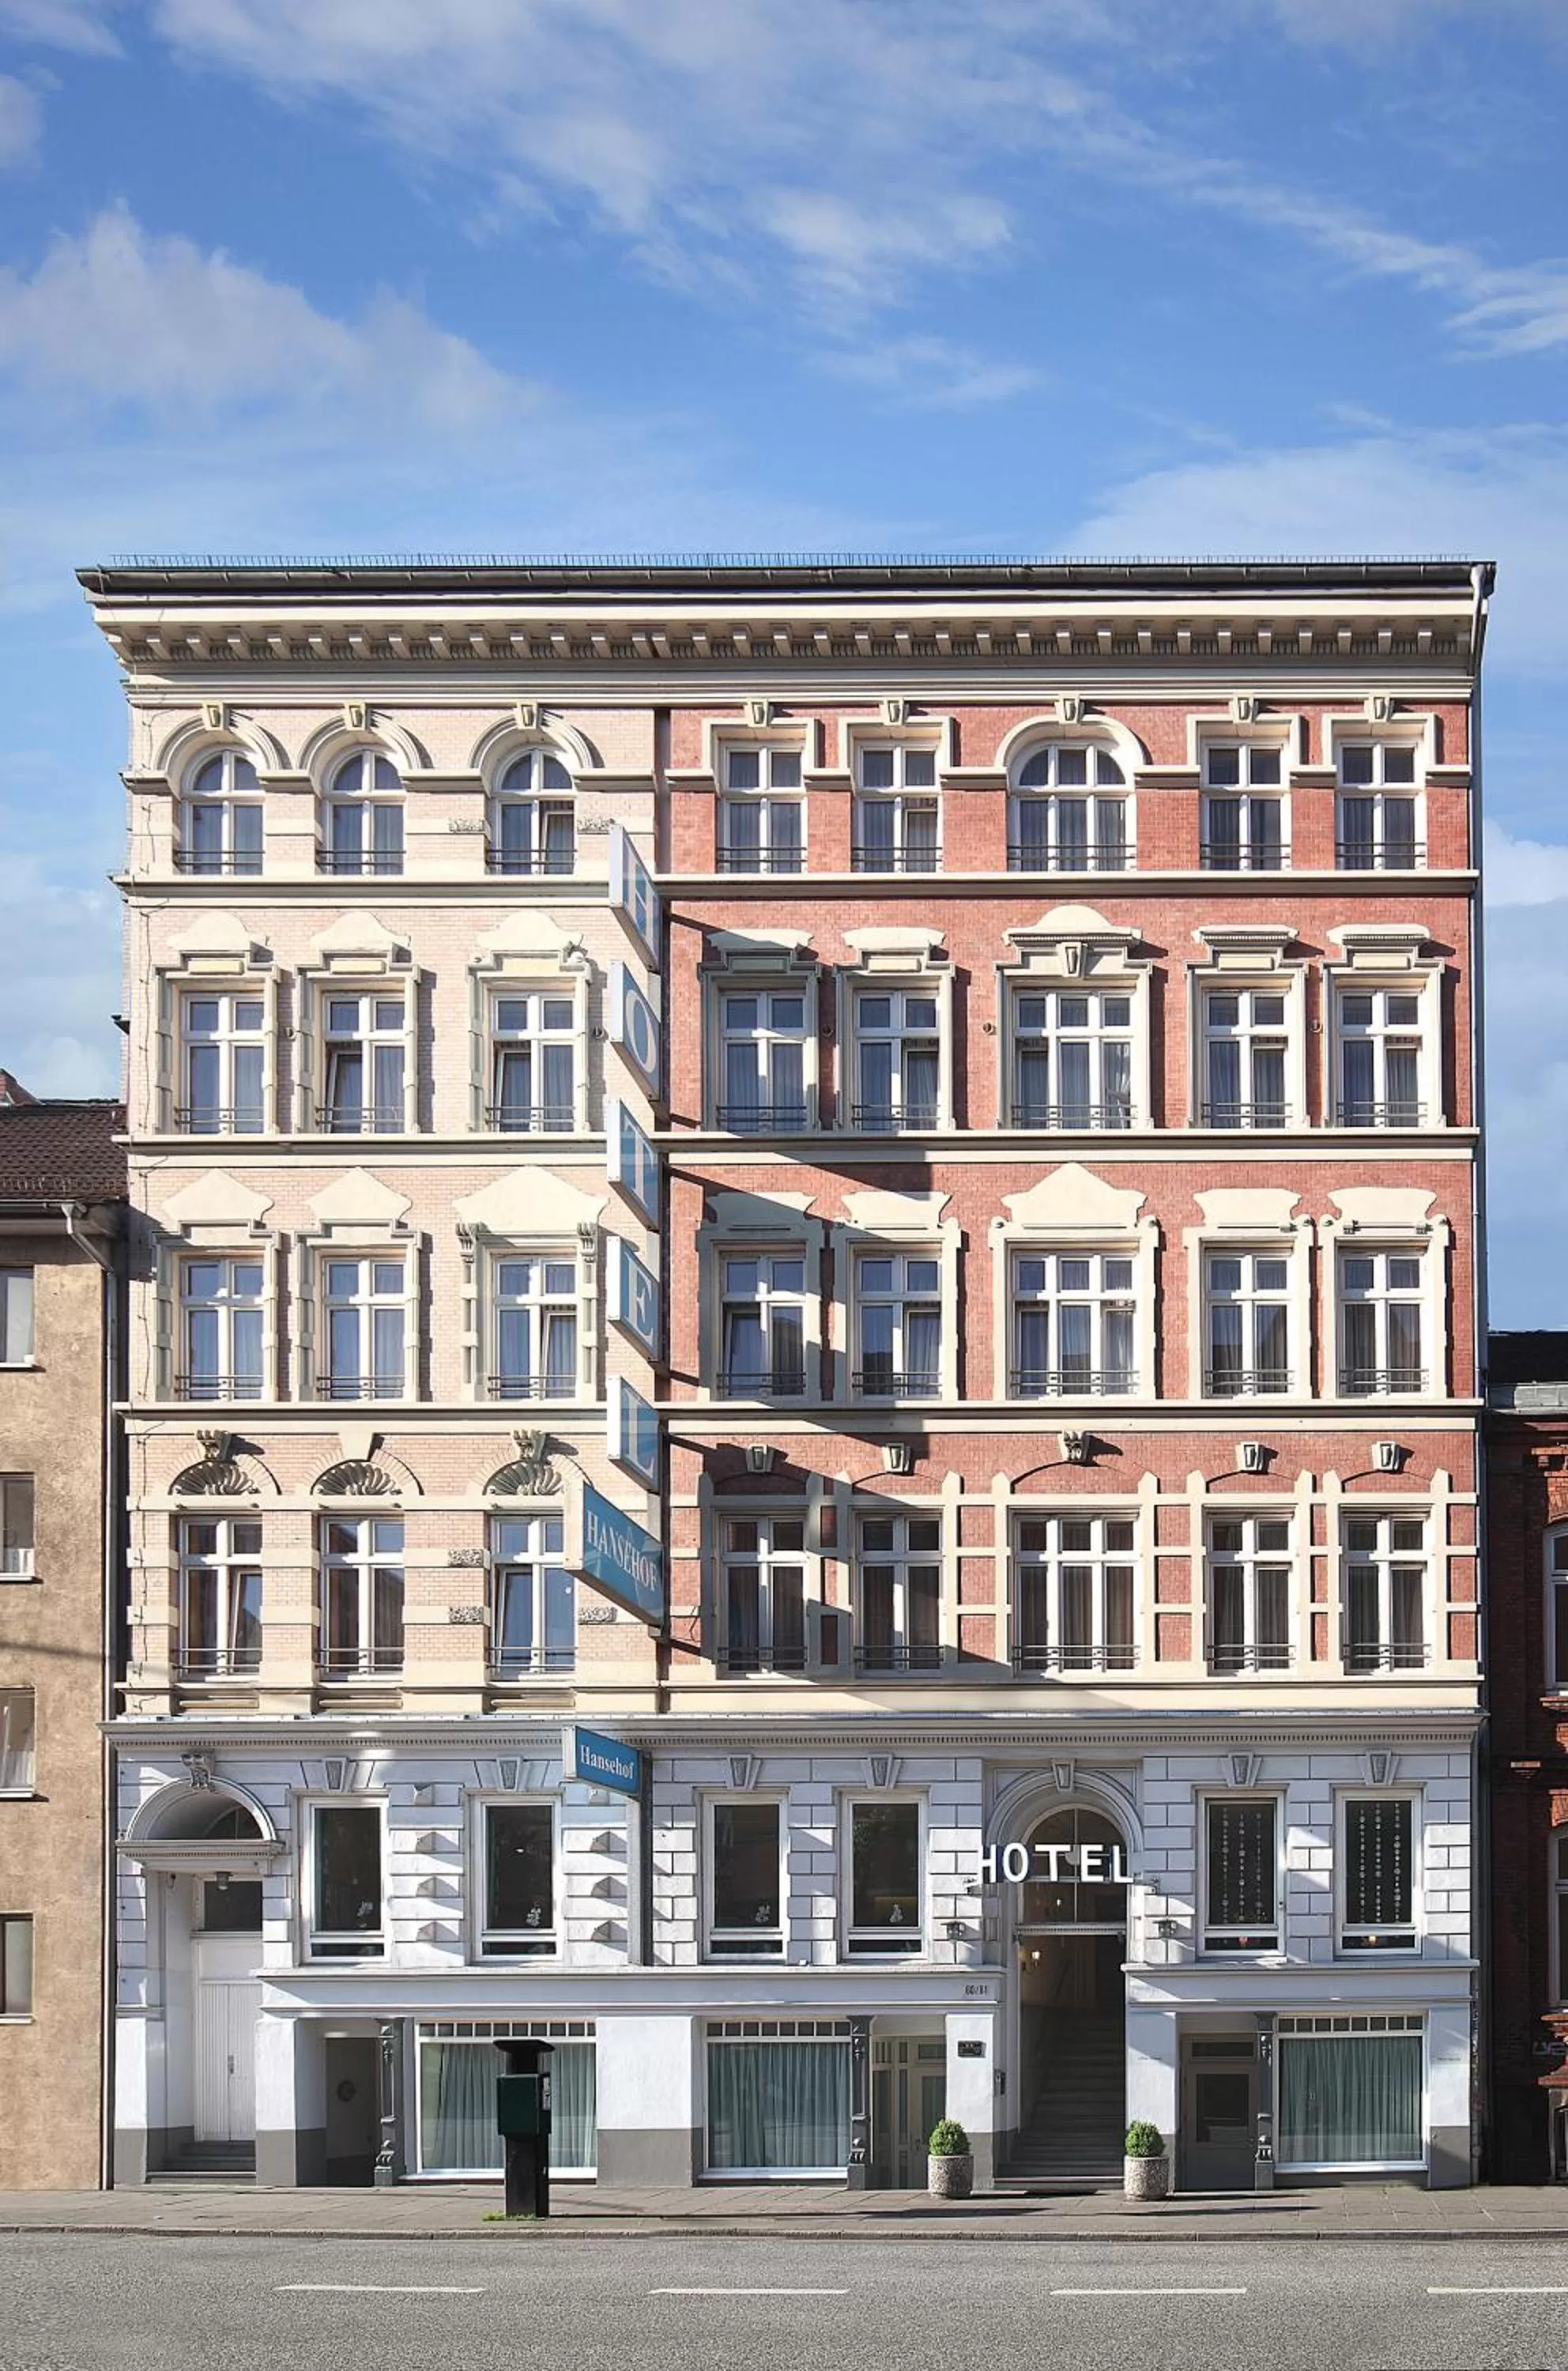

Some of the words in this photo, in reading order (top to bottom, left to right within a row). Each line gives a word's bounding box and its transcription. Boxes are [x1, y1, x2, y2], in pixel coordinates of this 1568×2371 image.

[623, 833, 658, 1480] HOTEL
[586, 1510, 658, 1593] HANSEHOF
[581, 1744, 634, 1780] Hansehof
[978, 1842, 1133, 1883] HOTEL
